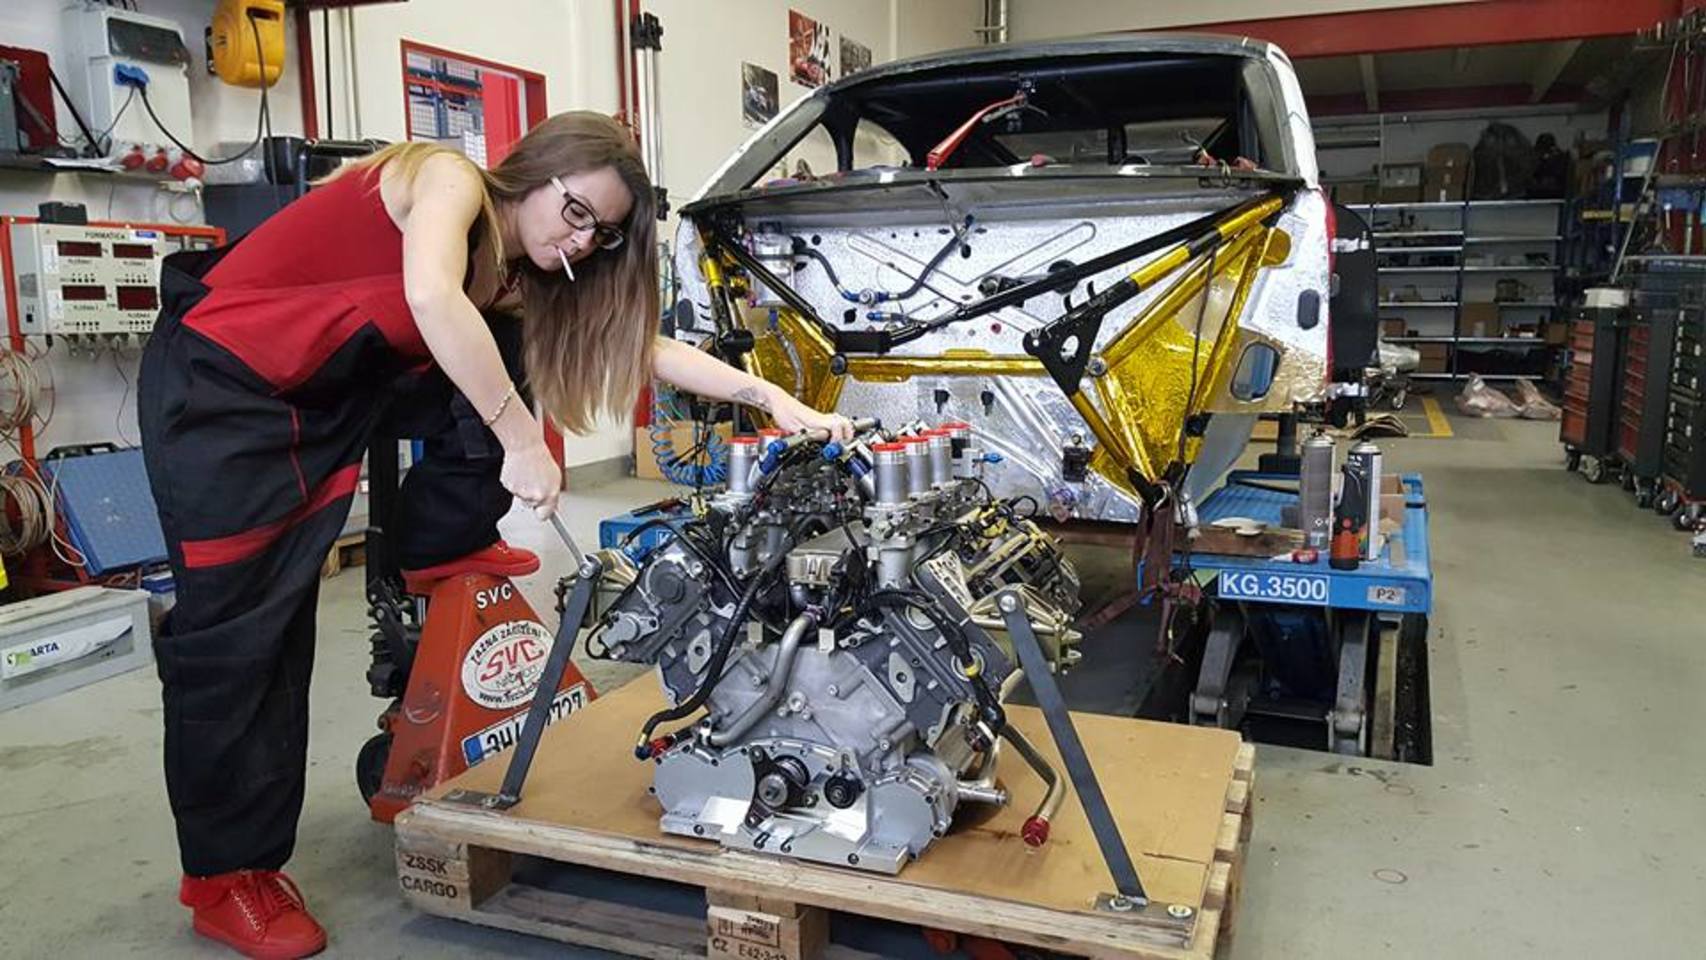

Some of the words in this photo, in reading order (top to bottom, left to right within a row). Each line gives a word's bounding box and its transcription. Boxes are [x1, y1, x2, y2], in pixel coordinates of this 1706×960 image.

[475, 583, 512, 609] SVC
[1222, 573, 1326, 600] KG.3500
[1376, 588, 1396, 601] P2
[29, 641, 59, 656] ARTA
[479, 637, 545, 682] SVC
[406, 854, 447, 875] ZSSK
[401, 875, 458, 898] CARGO
[712, 937, 728, 953] CZ
